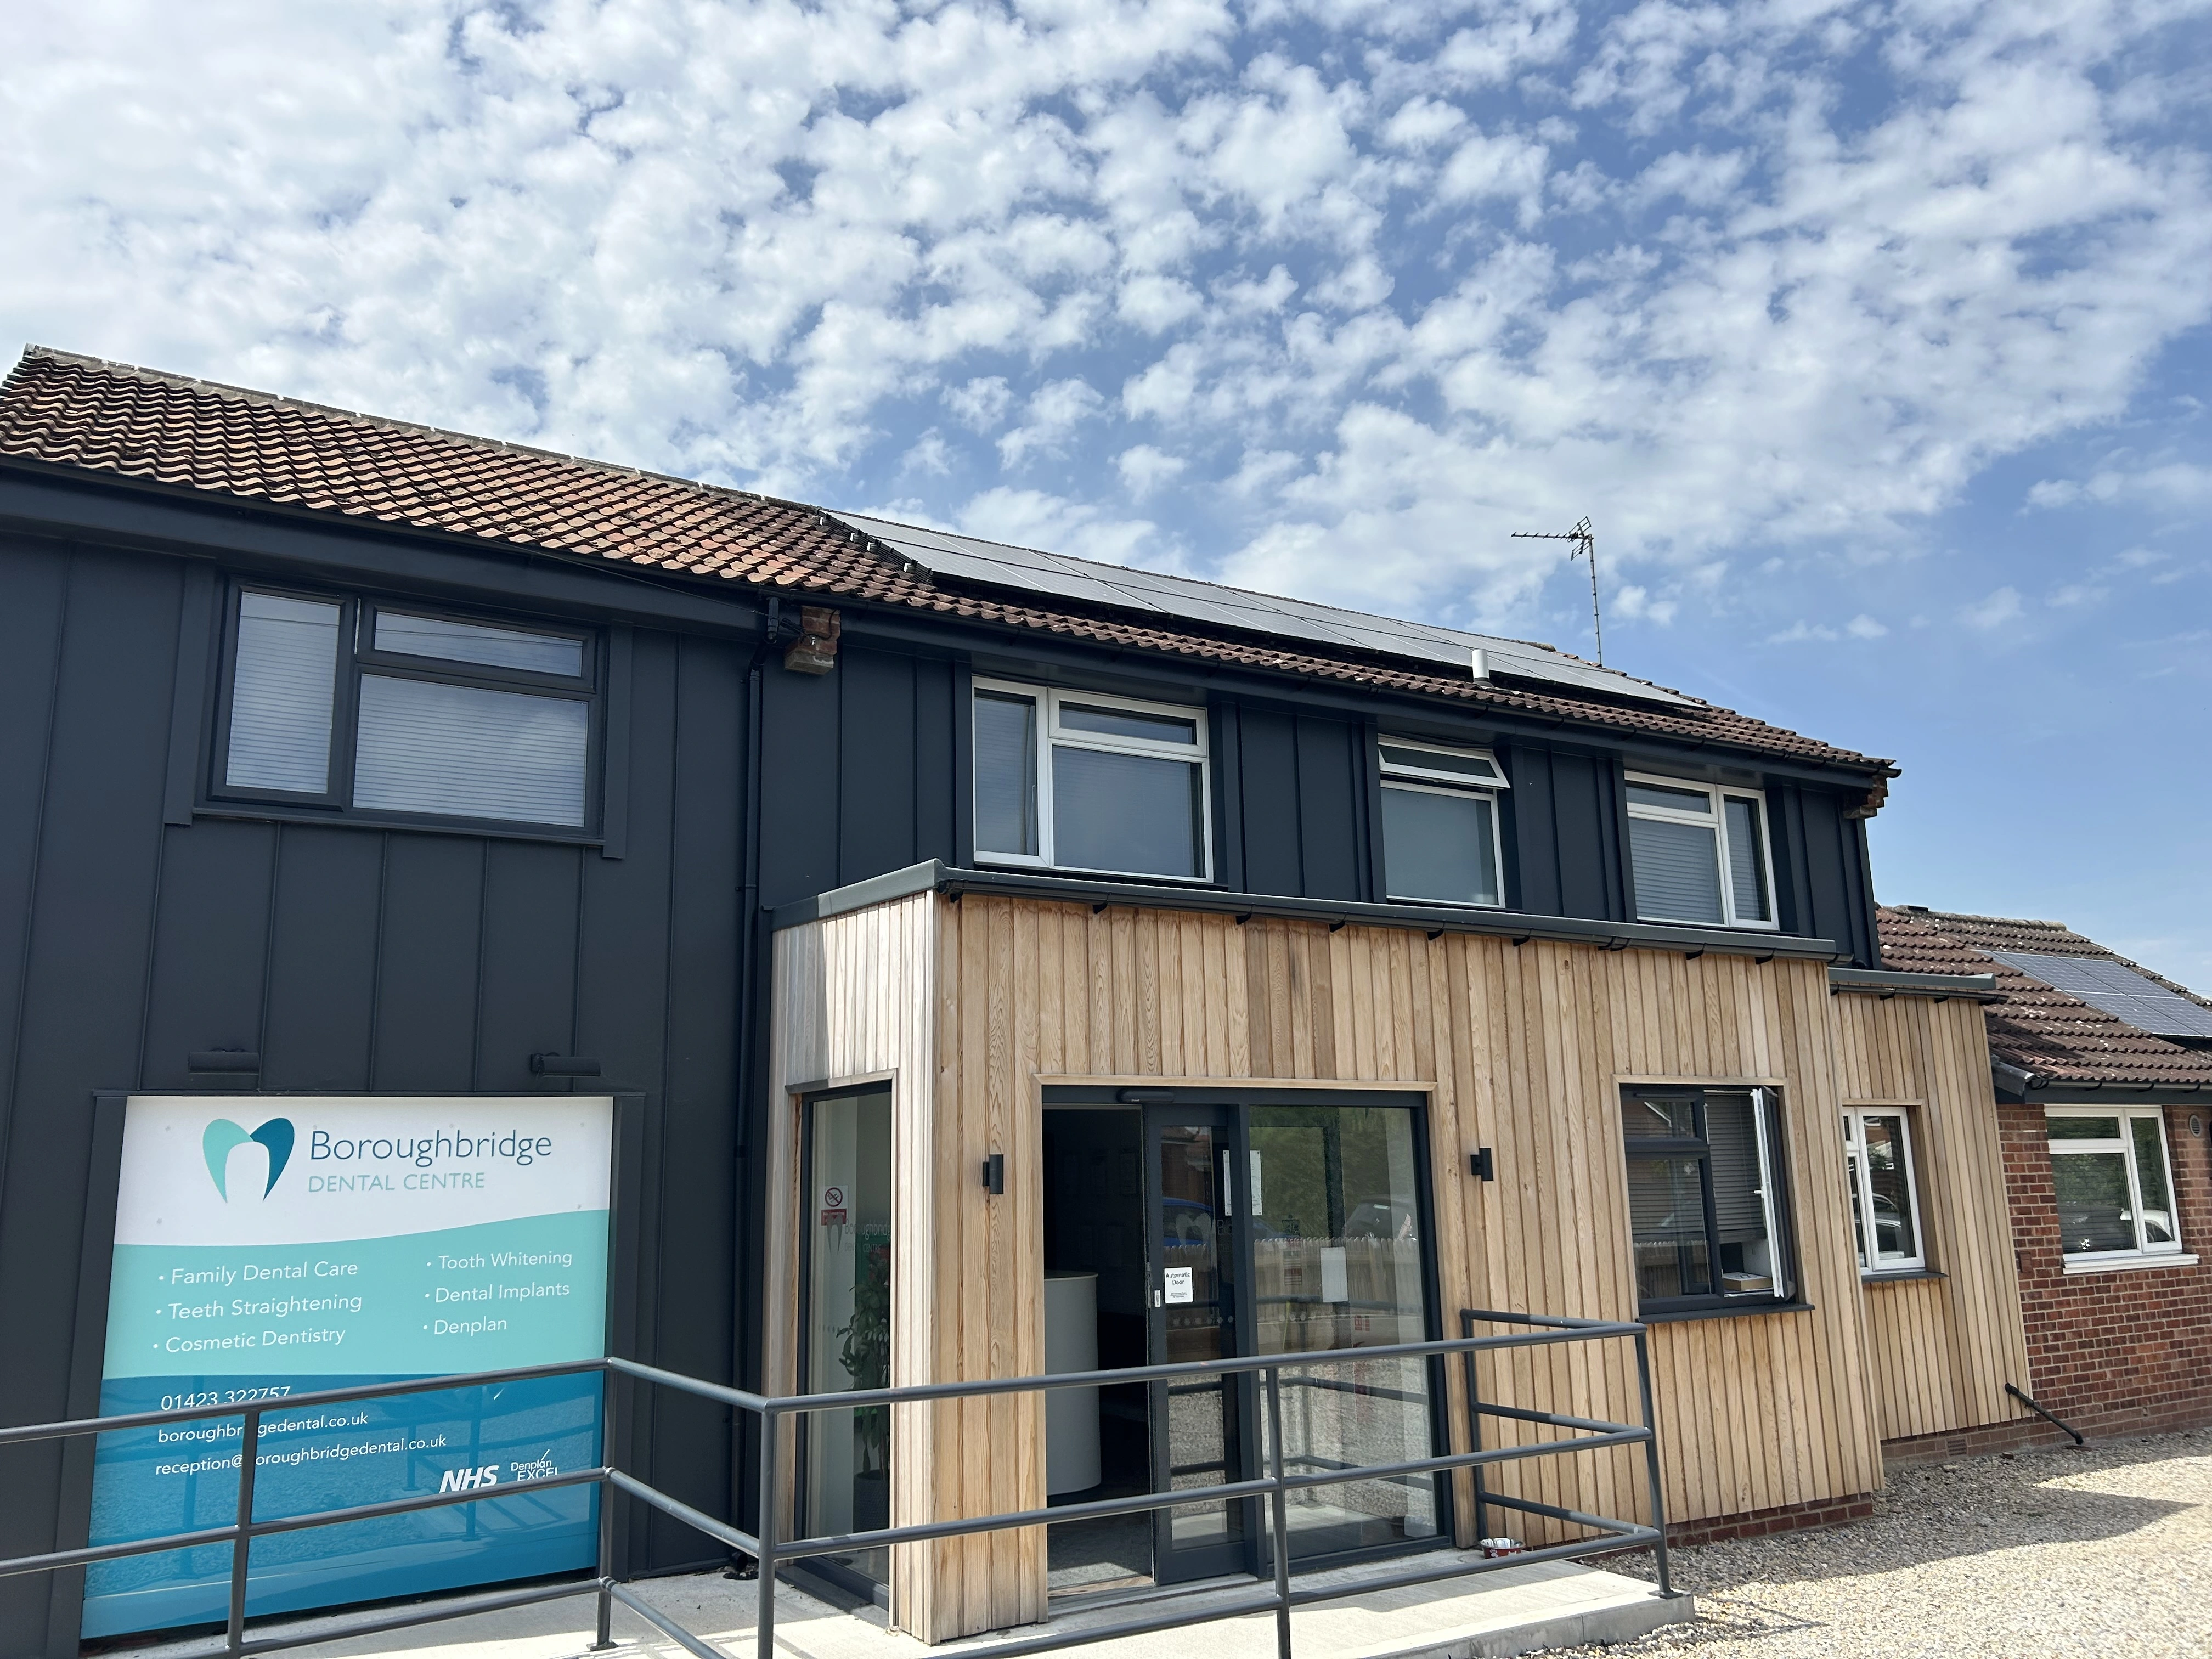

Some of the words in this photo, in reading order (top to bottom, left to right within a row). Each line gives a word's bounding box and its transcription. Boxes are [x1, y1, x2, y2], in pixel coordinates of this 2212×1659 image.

[311, 1129, 552, 1167] Boroughbridge
[308, 1175, 395, 1193] DENTAL
[403, 1172, 485, 1189] CENTRE
[438, 1253, 484, 1269] Tooth
[490, 1251, 572, 1267] Whitening
[171, 1266, 237, 1286] Family
[244, 1261, 308, 1281] Dental
[314, 1261, 358, 1277] Care
[436, 1284, 492, 1302] Dental
[499, 1282, 570, 1302] Implants
[168, 1300, 223, 1319] Teeth
[231, 1294, 362, 1317] Straightening
[434, 1316, 507, 1336] Denplan
[165, 1333, 256, 1353] Cosmetic
[262, 1328, 346, 1347] Dentistry
[161, 1392, 218, 1410] 01423
[224, 1386, 290, 1404] 322757
[159, 1412, 368, 1443] boroughbrgedental.co.uk
[156, 1434, 447, 1475] reception@oroughbridgedental.co.uk
[511, 1459, 552, 1471] Denplan
[439, 1465, 499, 1493] NHS
